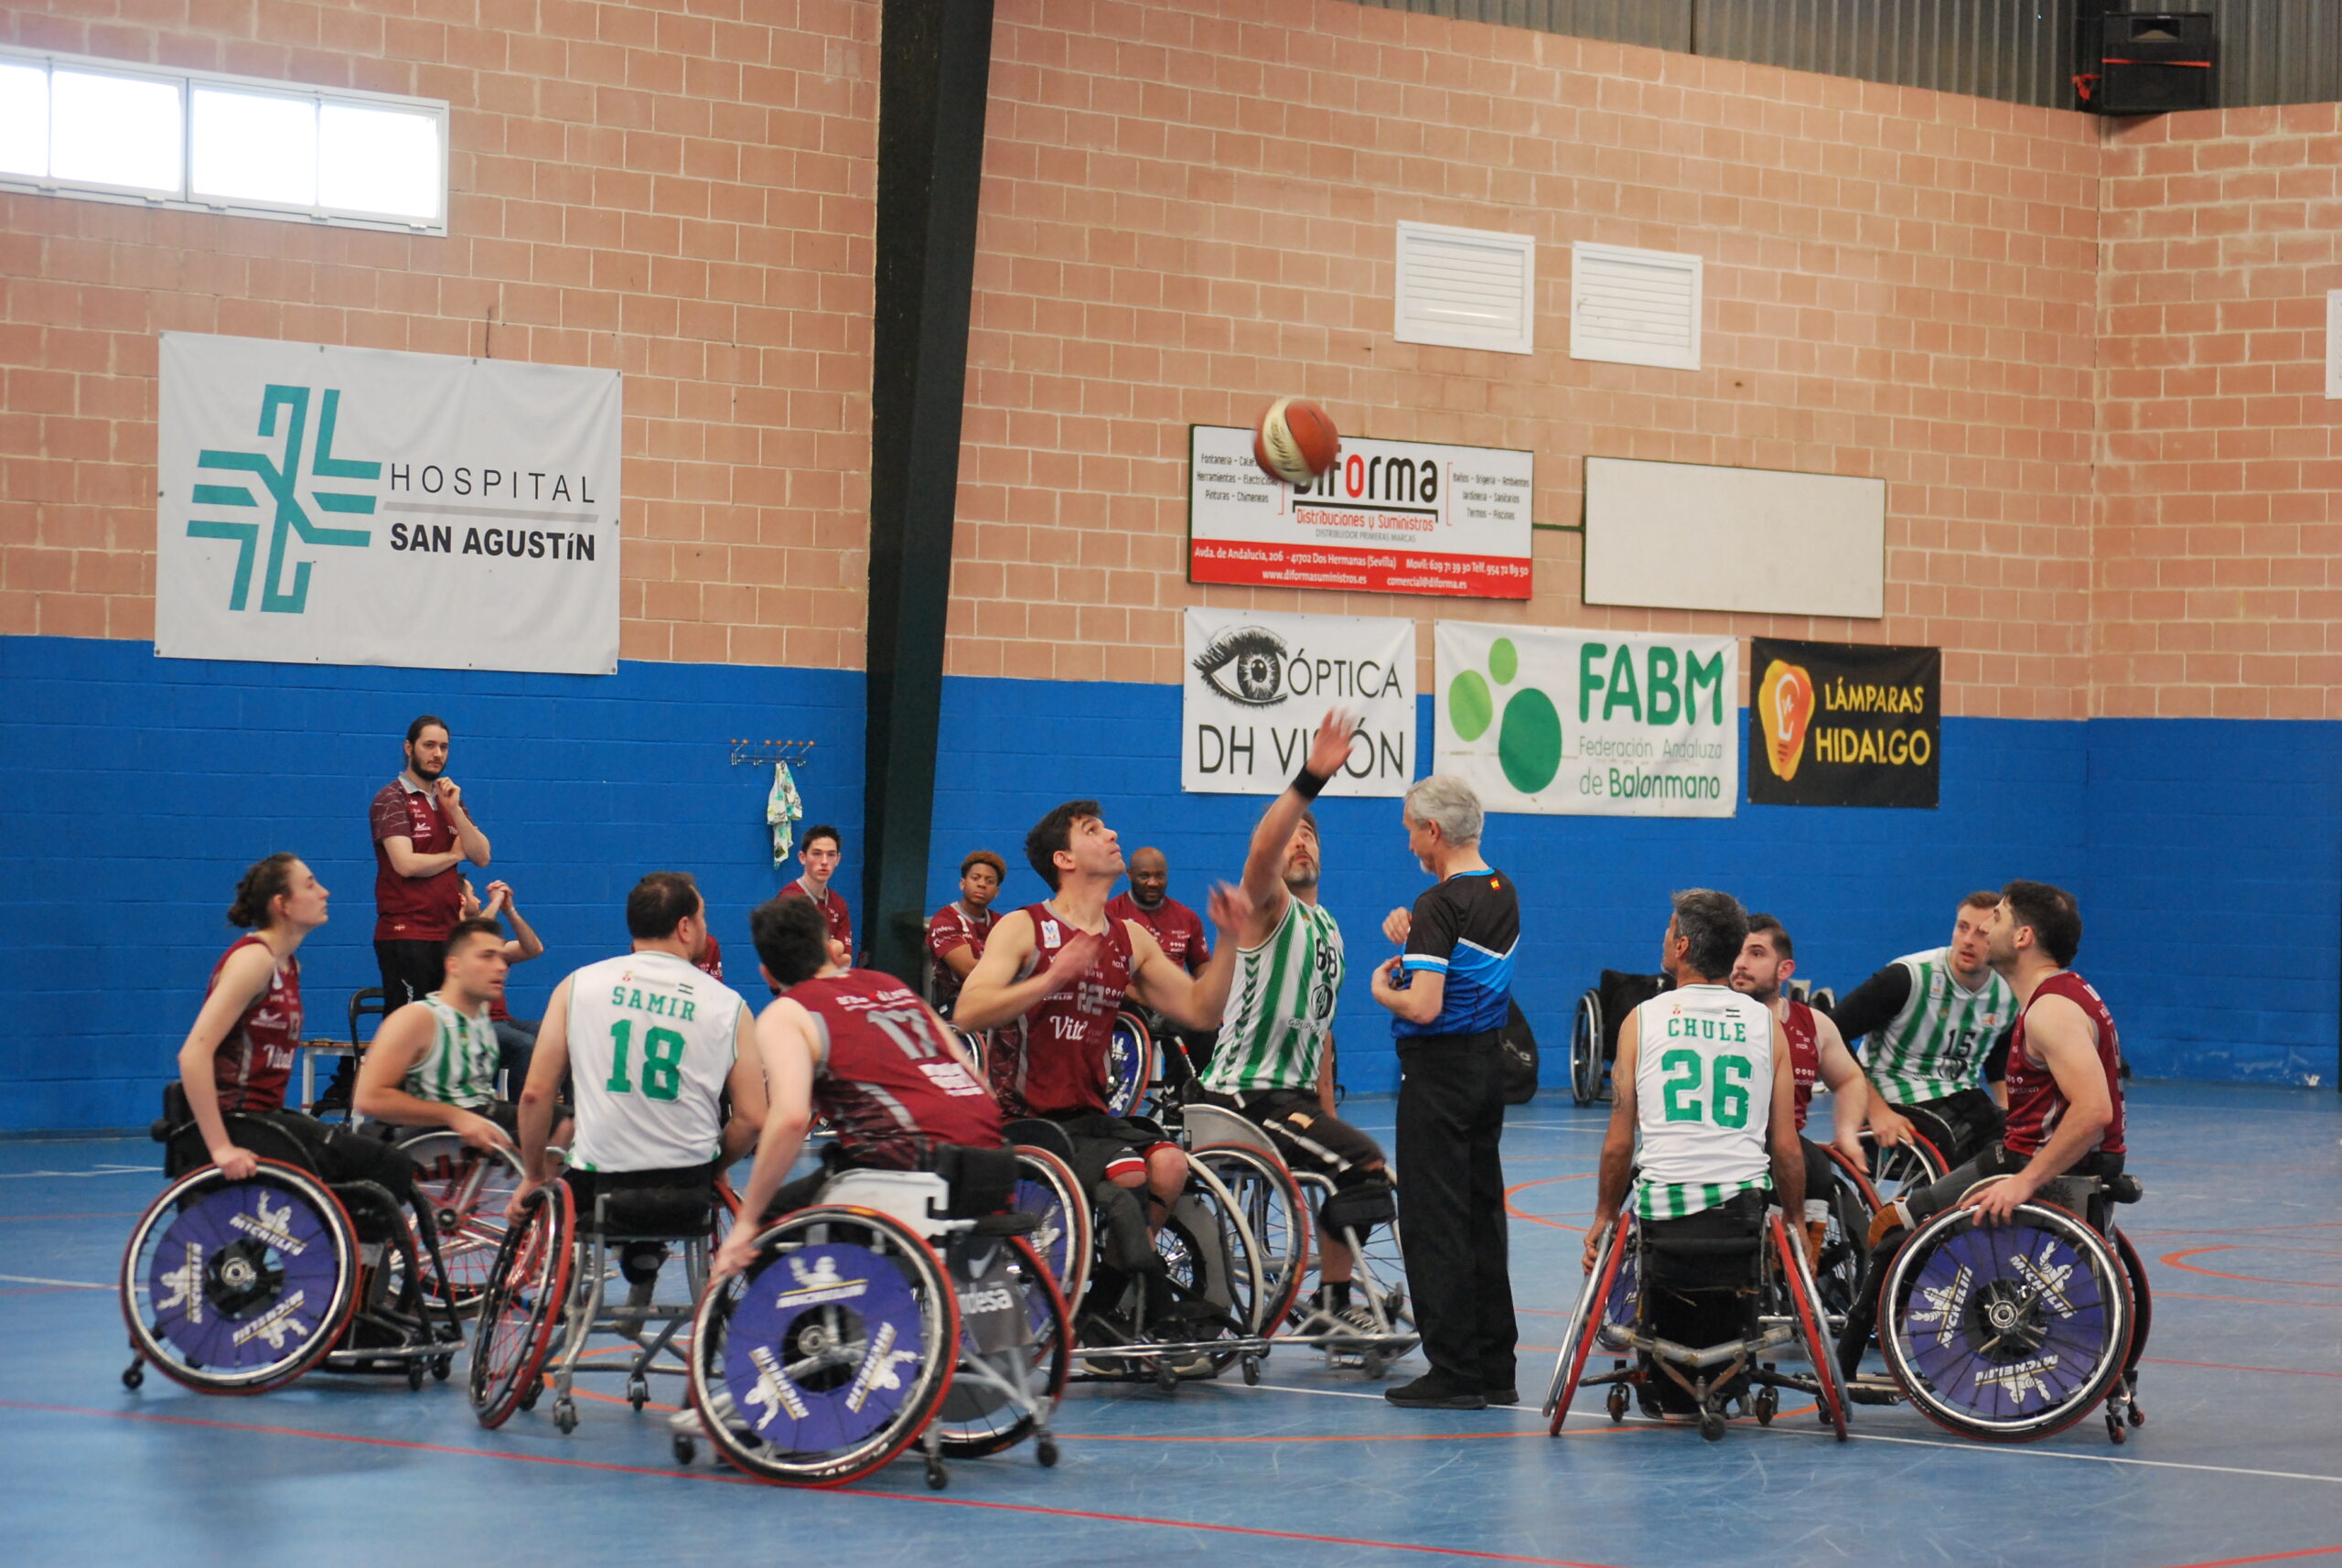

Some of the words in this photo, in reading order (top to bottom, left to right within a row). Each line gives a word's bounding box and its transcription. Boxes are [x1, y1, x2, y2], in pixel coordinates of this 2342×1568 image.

[391, 462, 596, 504] HOSPITAL
[390, 522, 452, 553] SAN
[1297, 508, 1365, 528] Distribuciones
[1369, 515, 1375, 531] y
[1379, 513, 1434, 532] Suministros
[1316, 529, 1359, 540] DISTRIBUIDOR
[1360, 531, 1390, 542] PRIMERAS
[1391, 533, 1415, 543] MARCAS
[1195, 546, 1216, 558] Avda.
[1217, 547, 1227, 559] de
[1269, 551, 1284, 562] 206
[1313, 553, 1327, 564] Dos
[1327, 553, 1366, 566] Hermanas
[1368, 554, 1396, 570] (Sevilla)
[1262, 569, 1367, 585] www.diformasuministros.es
[1387, 575, 1467, 590] comercial@diforma.es
[1287, 648, 1402, 698] ÓPTICA
[1579, 641, 1724, 725] FABM
[1824, 676, 1924, 714] LÁMPARAS
[1198, 724, 1253, 776] DH
[1272, 717, 1404, 779] VIÓN
[1579, 735, 1653, 758] Federación
[1663, 737, 1722, 760] Andaluza
[1815, 728, 1931, 766] HIDALGO
[1580, 768, 1603, 796] de
[1609, 767, 1720, 800] Balonmano
[611, 985, 696, 1022] SAMIR
[1668, 1017, 1746, 1043] CHULE
[1942, 1028, 1976, 1058] 15
[606, 1019, 686, 1101] 18
[1661, 1049, 1753, 1130] 26
[2009, 1255, 2075, 1319] MICHELIN
[1940, 1265, 1973, 1348] MICHELIN
[1975, 1354, 2058, 1382] MICHELIN
